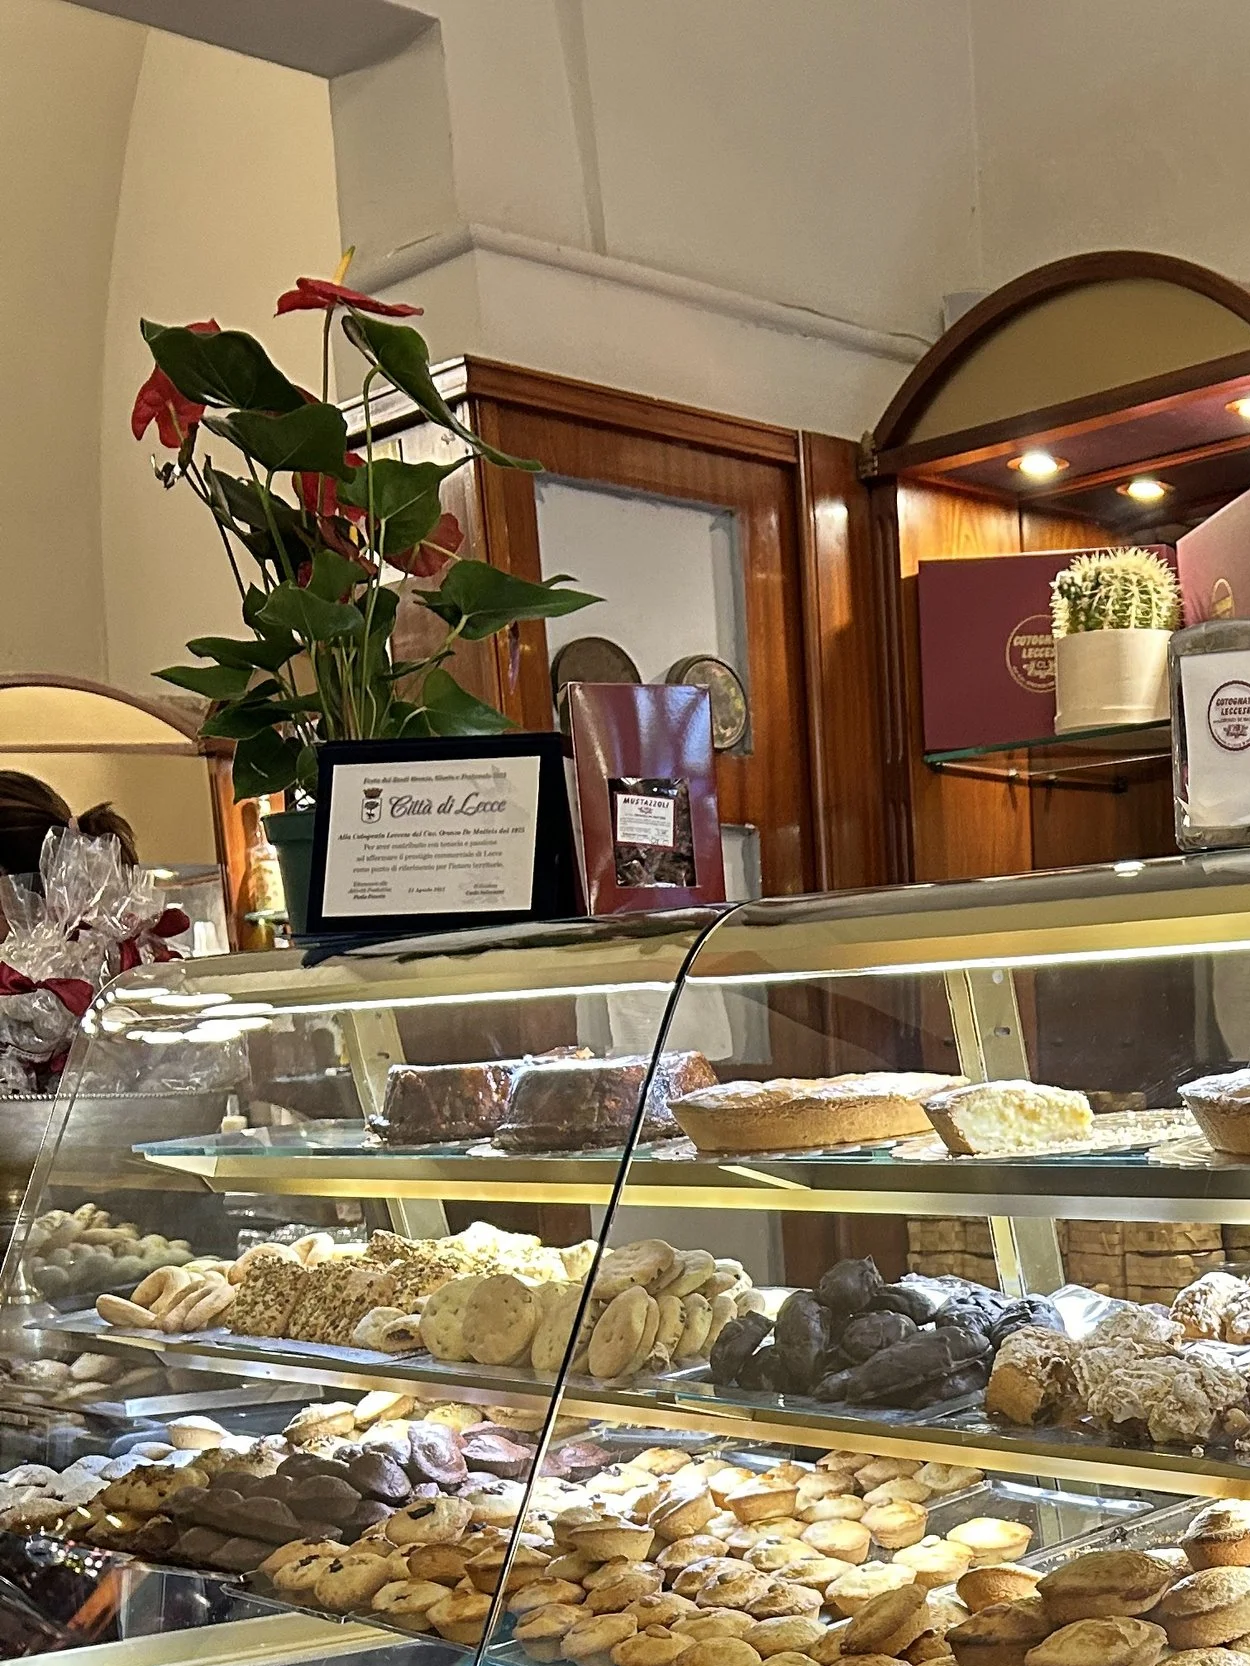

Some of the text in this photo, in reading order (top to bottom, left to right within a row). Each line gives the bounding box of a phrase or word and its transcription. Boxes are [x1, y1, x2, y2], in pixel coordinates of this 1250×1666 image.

[1013, 634, 1053, 646] COTOGN
[1221, 707, 1250, 716] LECCESE
[389, 792, 506, 819] Città di Lecce
[623, 797, 670, 809] MUSTAZZOLI
